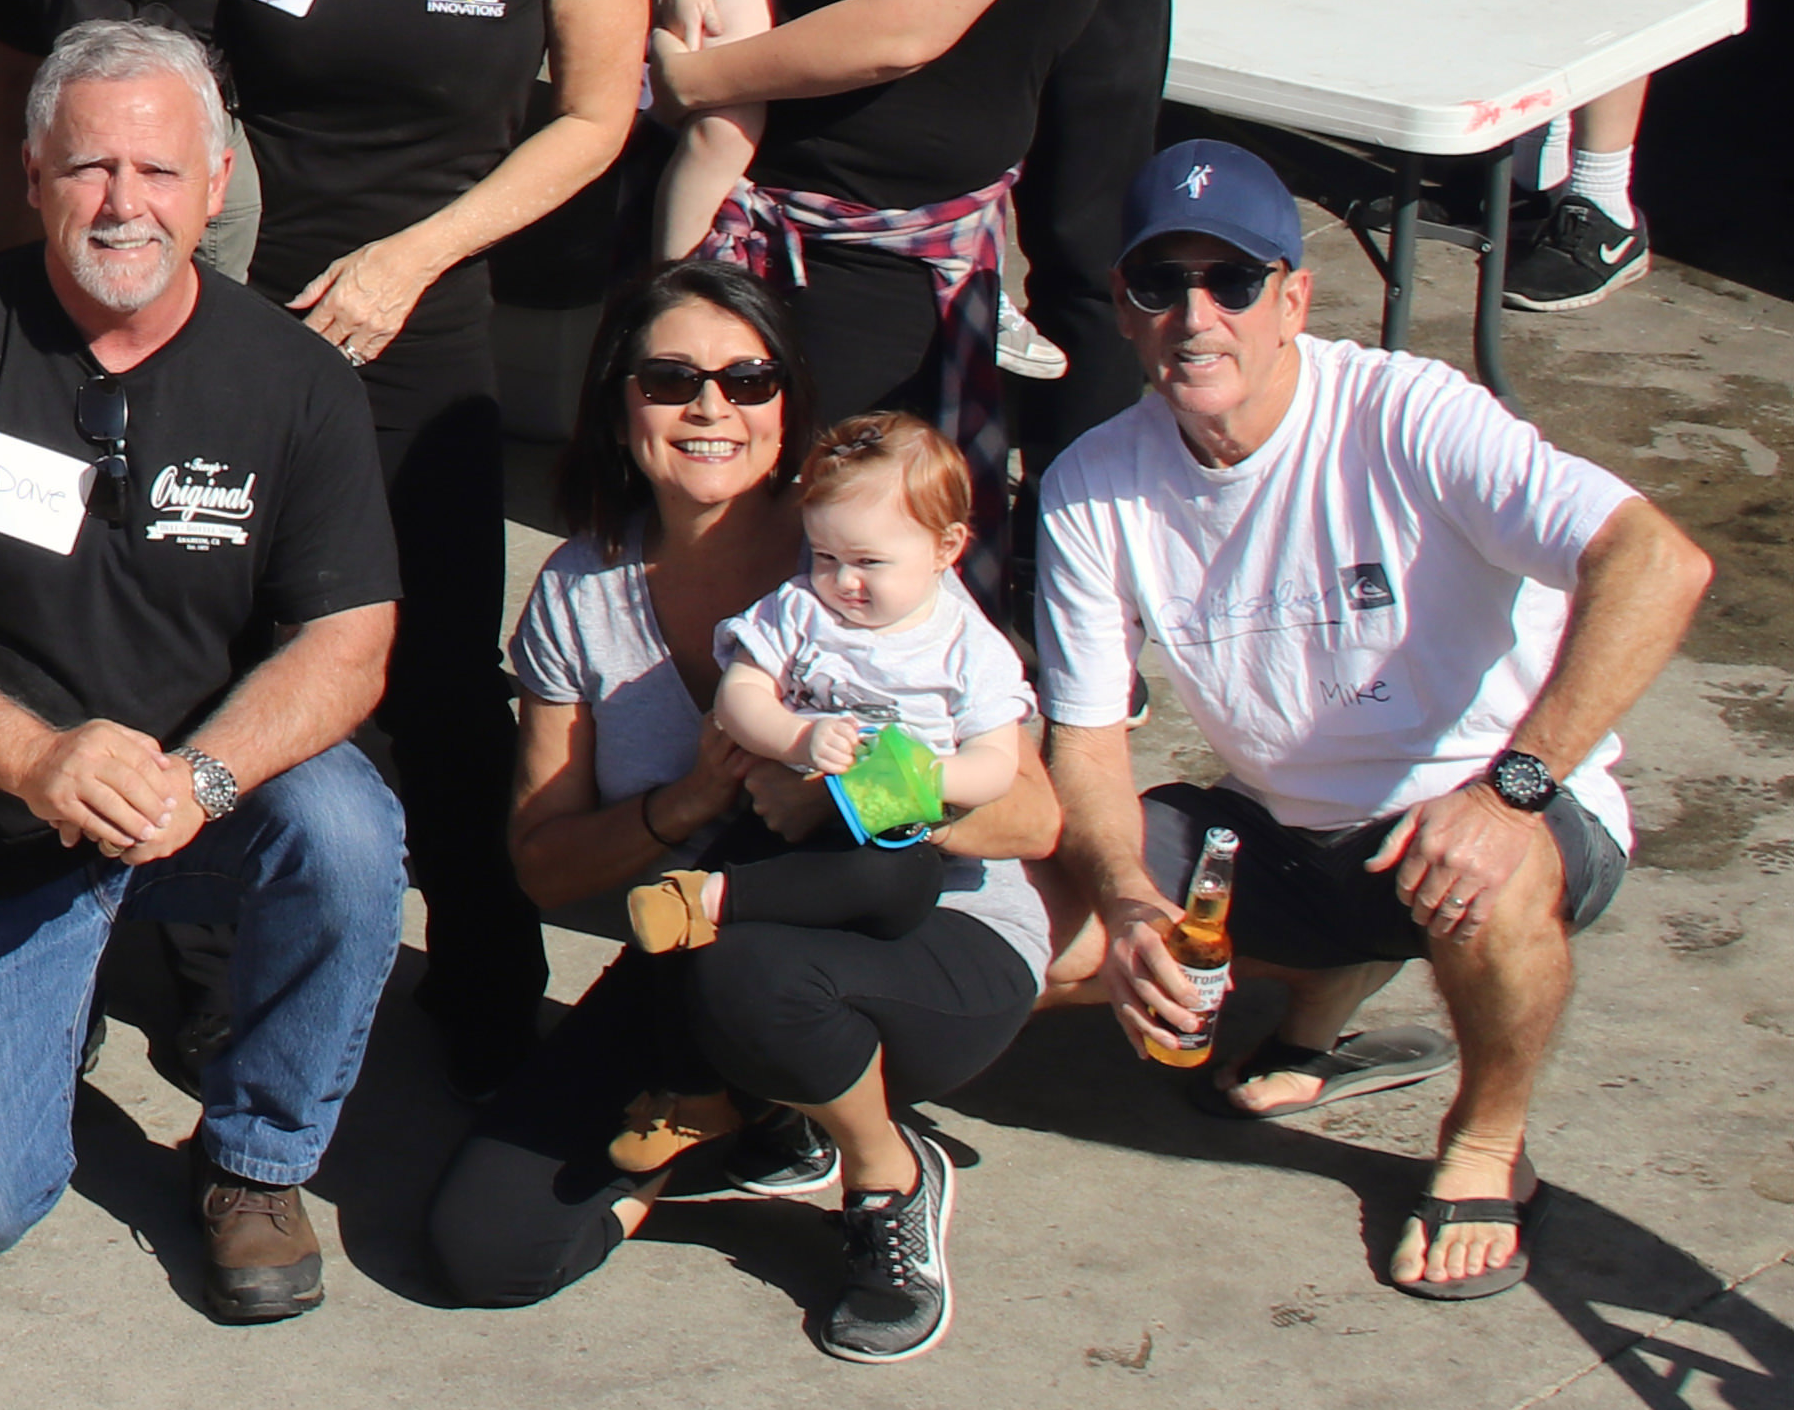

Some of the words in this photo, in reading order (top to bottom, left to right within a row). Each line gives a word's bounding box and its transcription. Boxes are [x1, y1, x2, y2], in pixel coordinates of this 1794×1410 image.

[427, 1, 505, 18] INNOVATIONS
[150, 465, 256, 521] Original
[1320, 677, 1392, 708] Mike
